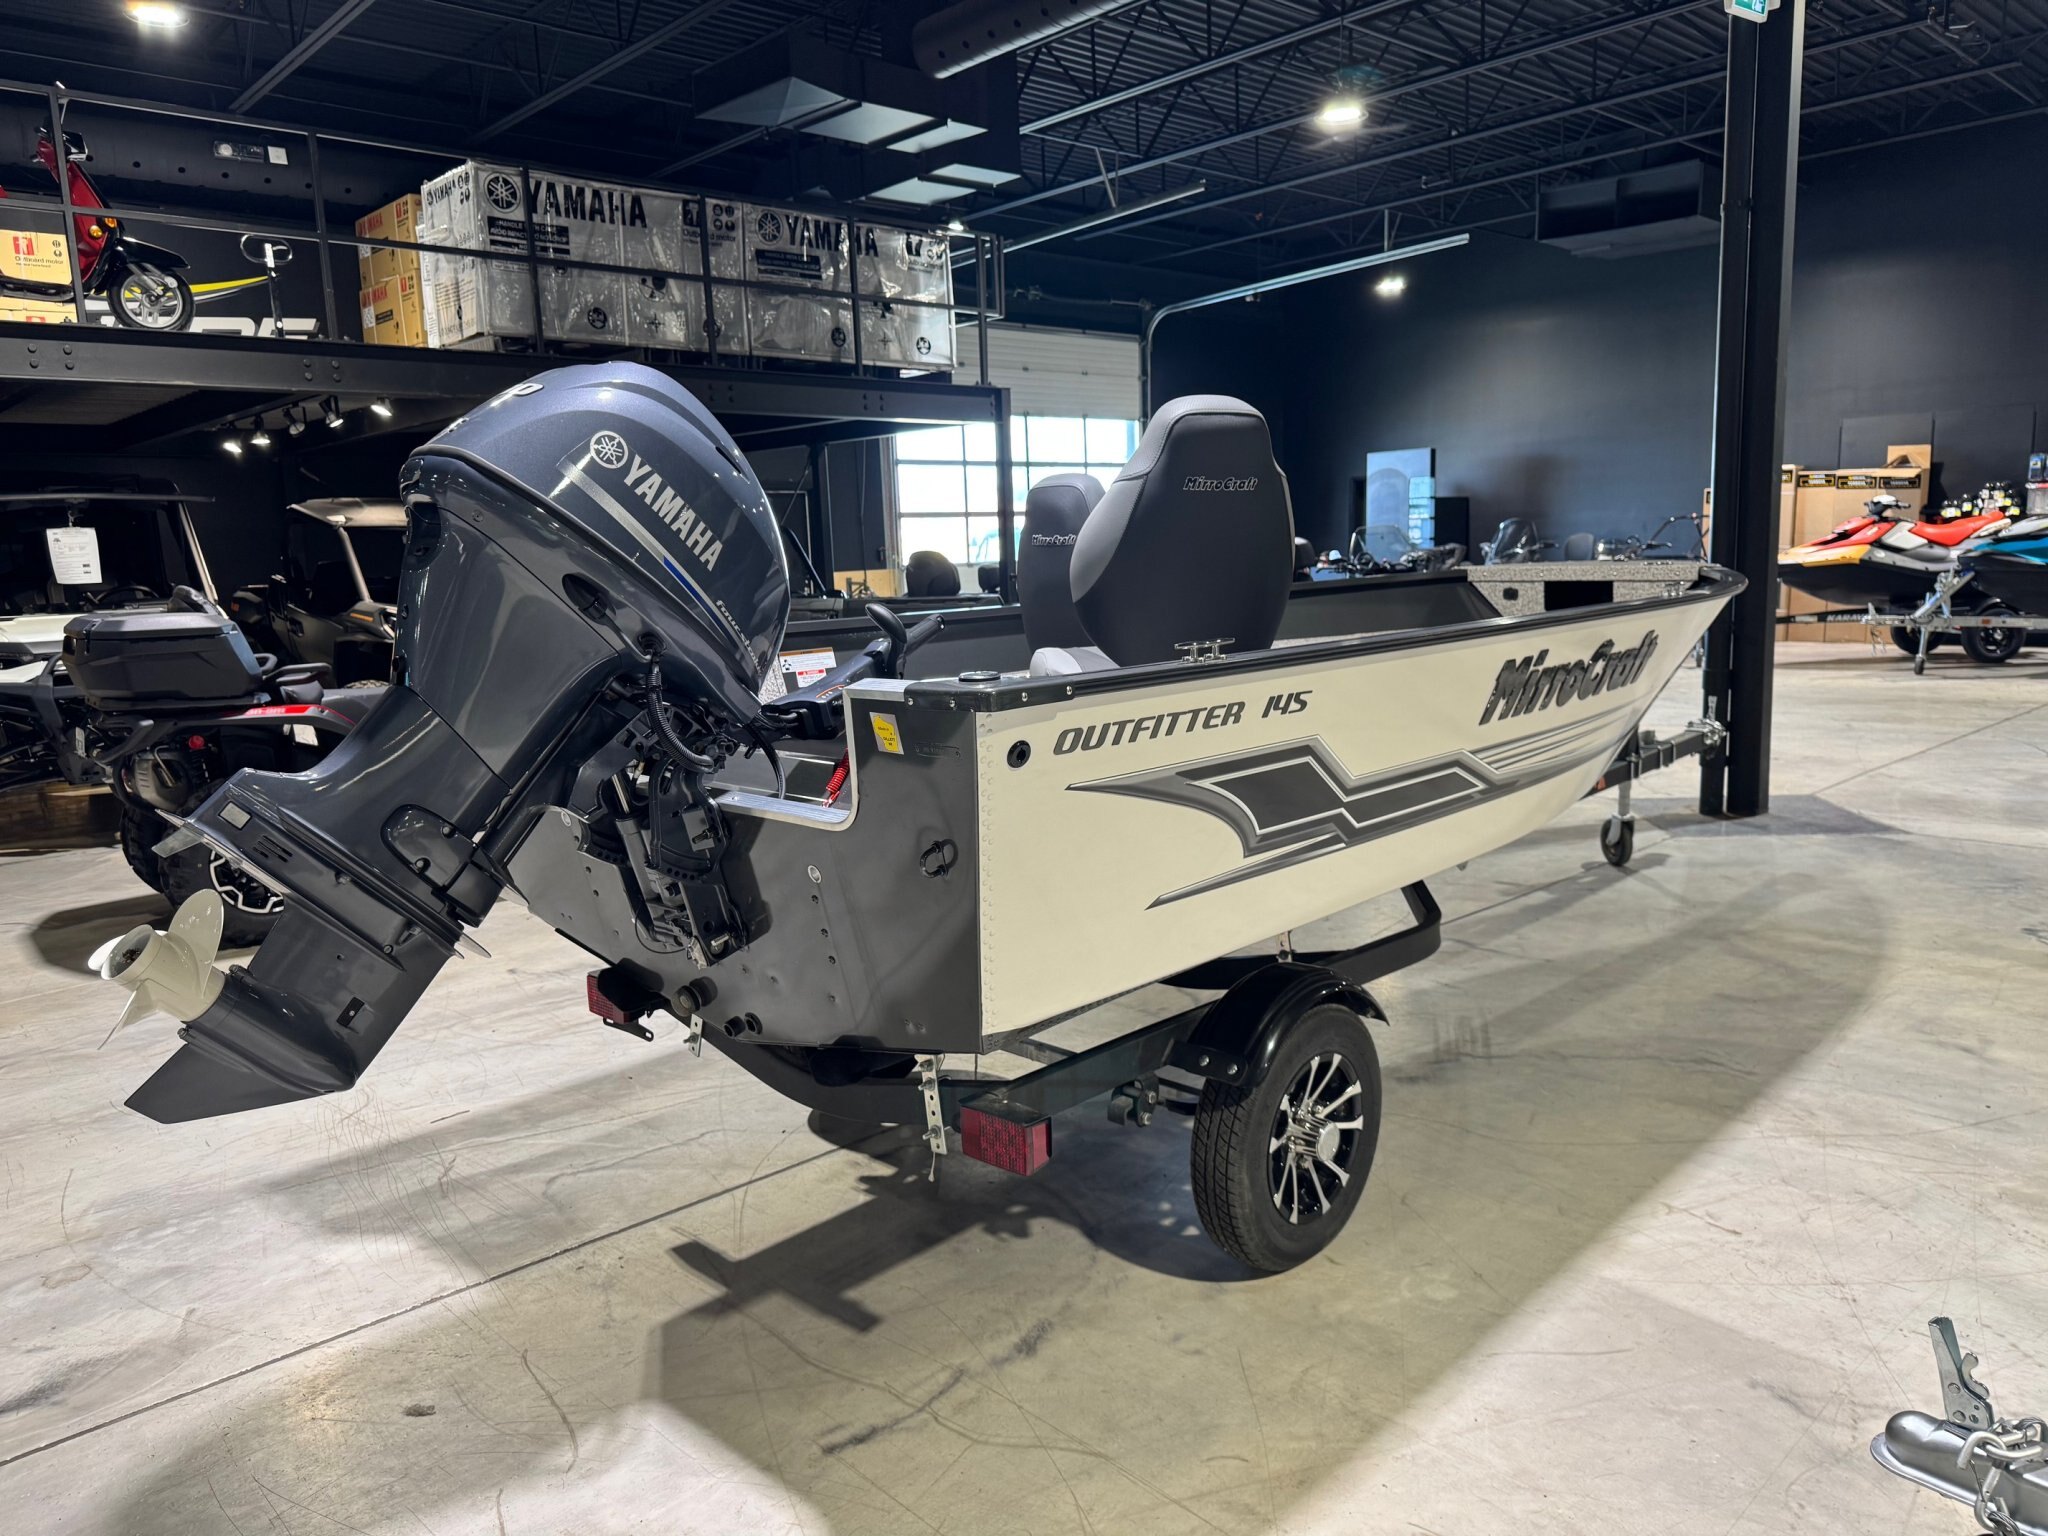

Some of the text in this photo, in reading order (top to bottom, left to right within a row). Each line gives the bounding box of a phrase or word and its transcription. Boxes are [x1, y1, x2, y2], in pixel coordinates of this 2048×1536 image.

[527, 180, 648, 229] YAMAHA
[623, 453, 724, 572] YAMAHA
[1183, 476, 1258, 491] MirroCraft
[1478, 629, 1660, 726] MirroCraft
[1052, 690, 1313, 756] OUTFITTER 145
